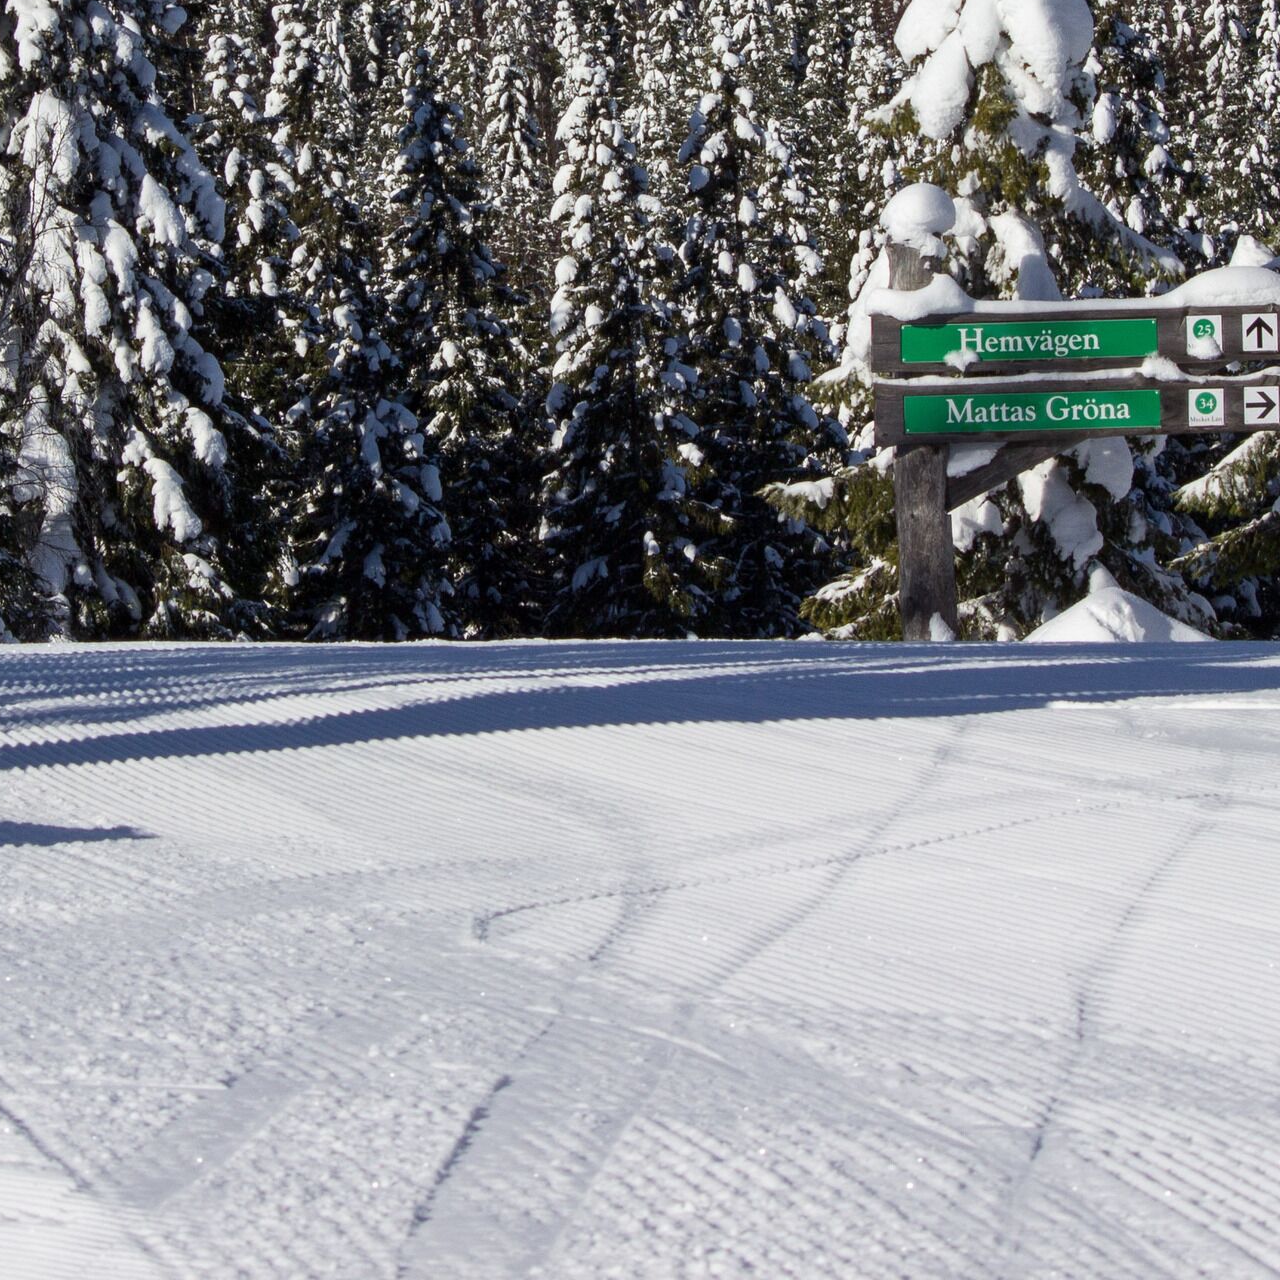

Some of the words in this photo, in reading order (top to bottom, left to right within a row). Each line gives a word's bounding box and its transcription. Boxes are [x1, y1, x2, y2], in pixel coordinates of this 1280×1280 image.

[1197, 325, 1212, 336] 25
[958, 327, 1100, 356] Hemvägen
[946, 398, 1036, 424] Mattas
[1045, 395, 1131, 421] Gröna
[1199, 398, 1215, 409] 34
